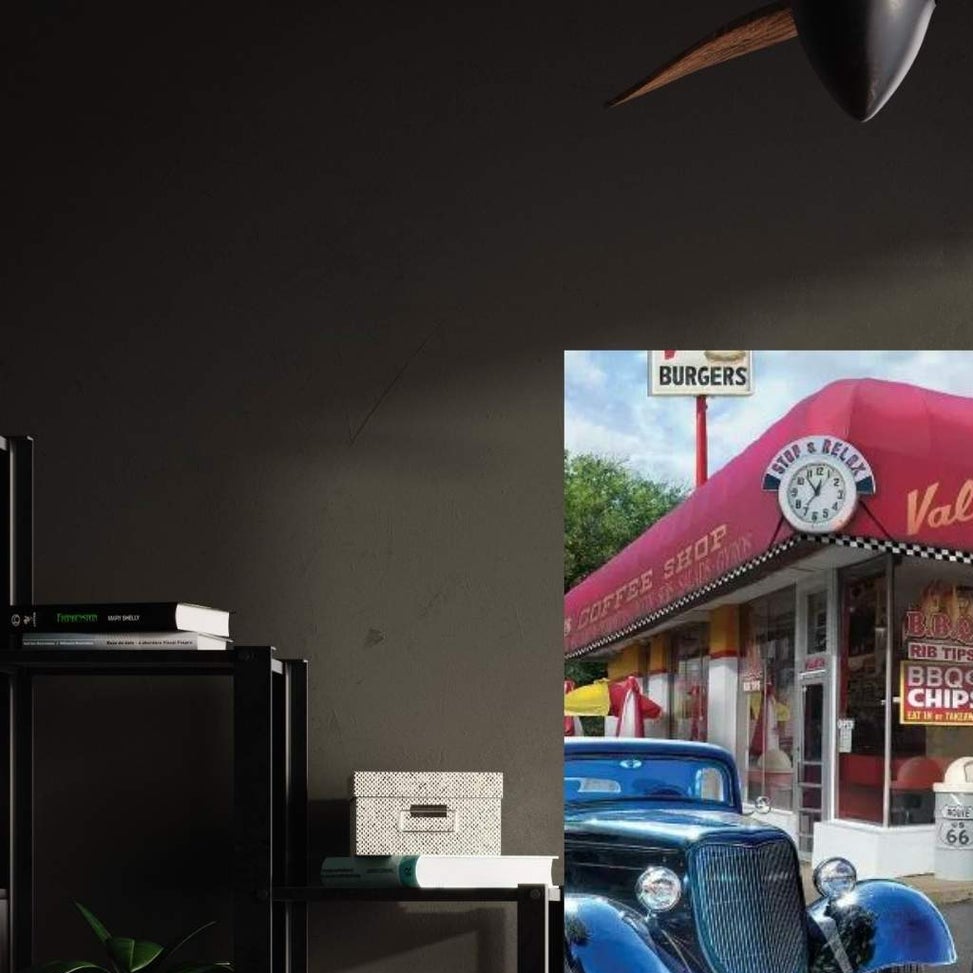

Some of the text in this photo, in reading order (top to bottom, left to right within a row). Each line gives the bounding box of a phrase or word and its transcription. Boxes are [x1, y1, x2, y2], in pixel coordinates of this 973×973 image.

[659, 365, 747, 386] BURGERS
[806, 441, 817, 454] &
[578, 571, 653, 629] COFFEE
[664, 524, 726, 578] SHOP
[910, 644, 938, 659] RIB
[907, 665, 963, 688] BBQ
[908, 710, 921, 720] EAT
[946, 829, 970, 845] 66
